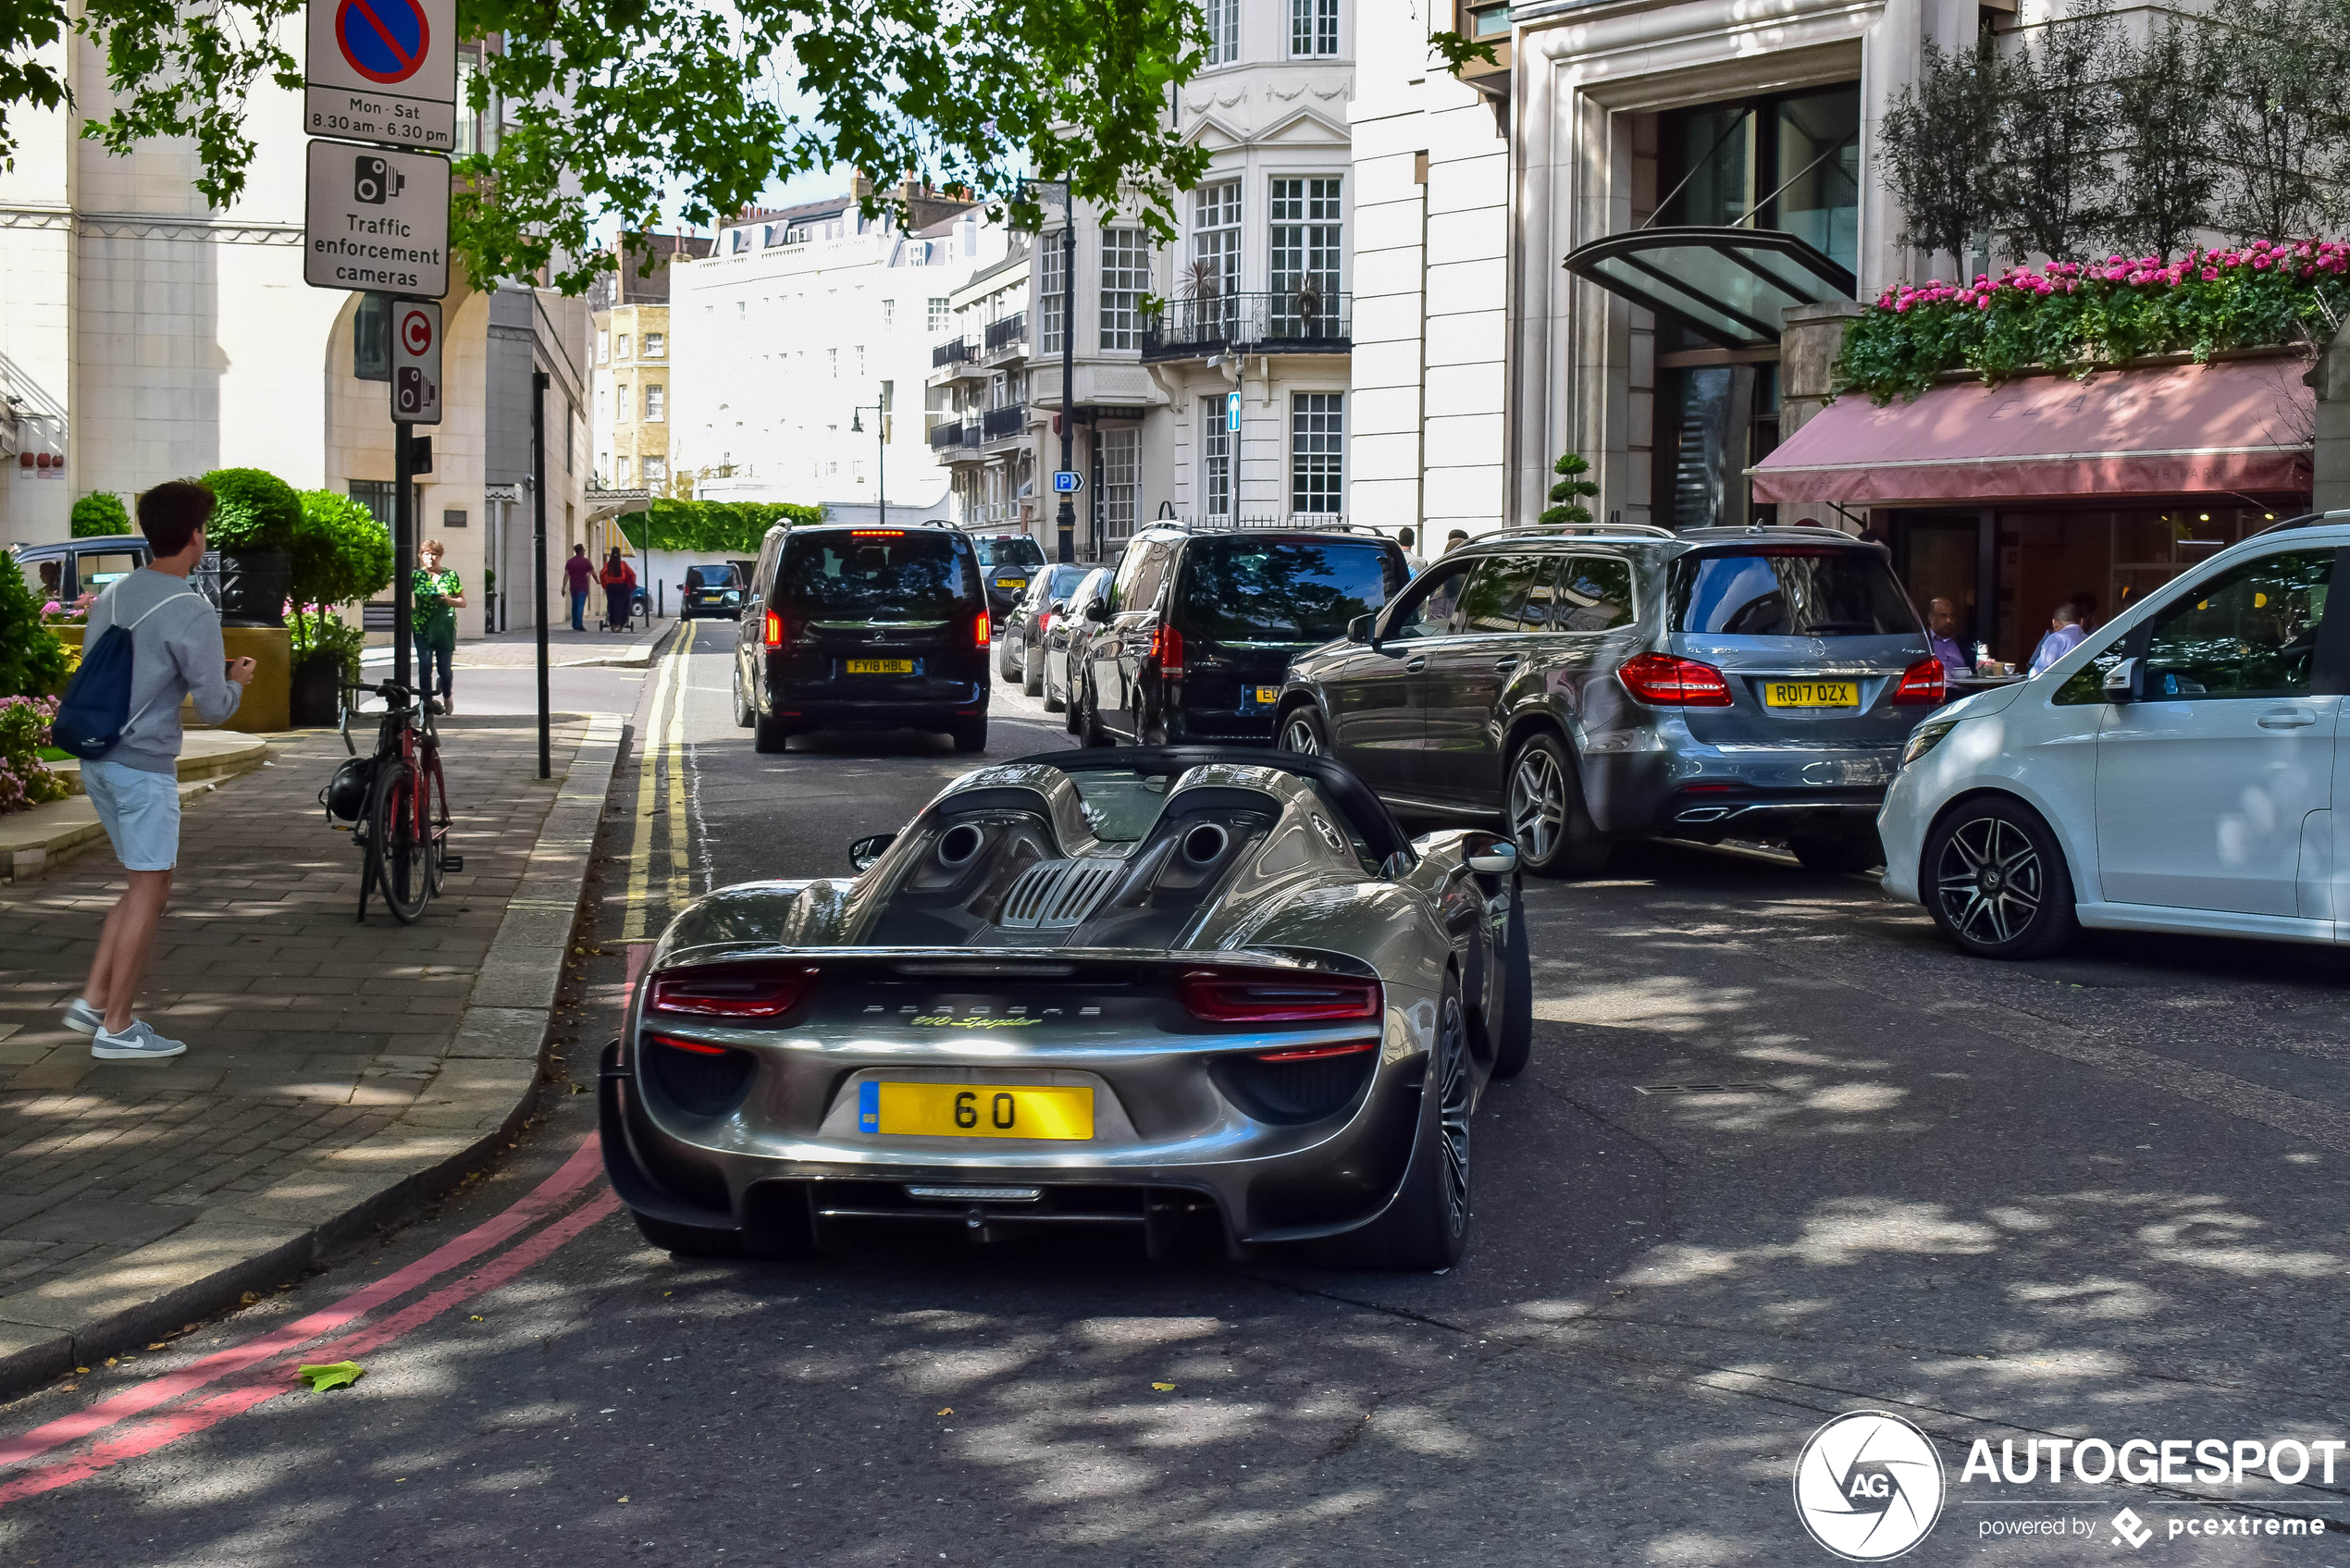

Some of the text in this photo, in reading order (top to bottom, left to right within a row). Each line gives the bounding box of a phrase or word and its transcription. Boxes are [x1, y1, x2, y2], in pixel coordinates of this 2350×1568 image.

[350, 98, 381, 114] Mon
[394, 104, 420, 119] Sat
[313, 113, 349, 130] 8.30
[352, 120, 375, 133] am
[387, 122, 423, 139] 6.30
[426, 130, 448, 142] pm
[346, 213, 411, 238] Traffic
[315, 238, 439, 265] enforcement
[336, 266, 417, 287] cameras
[1059, 475, 1070, 488] P
[2151, 468, 2171, 480] 48
[2180, 467, 2223, 480] PARK
[854, 661, 906, 672] FY18 HBL
[1817, 685, 1848, 701] OZX
